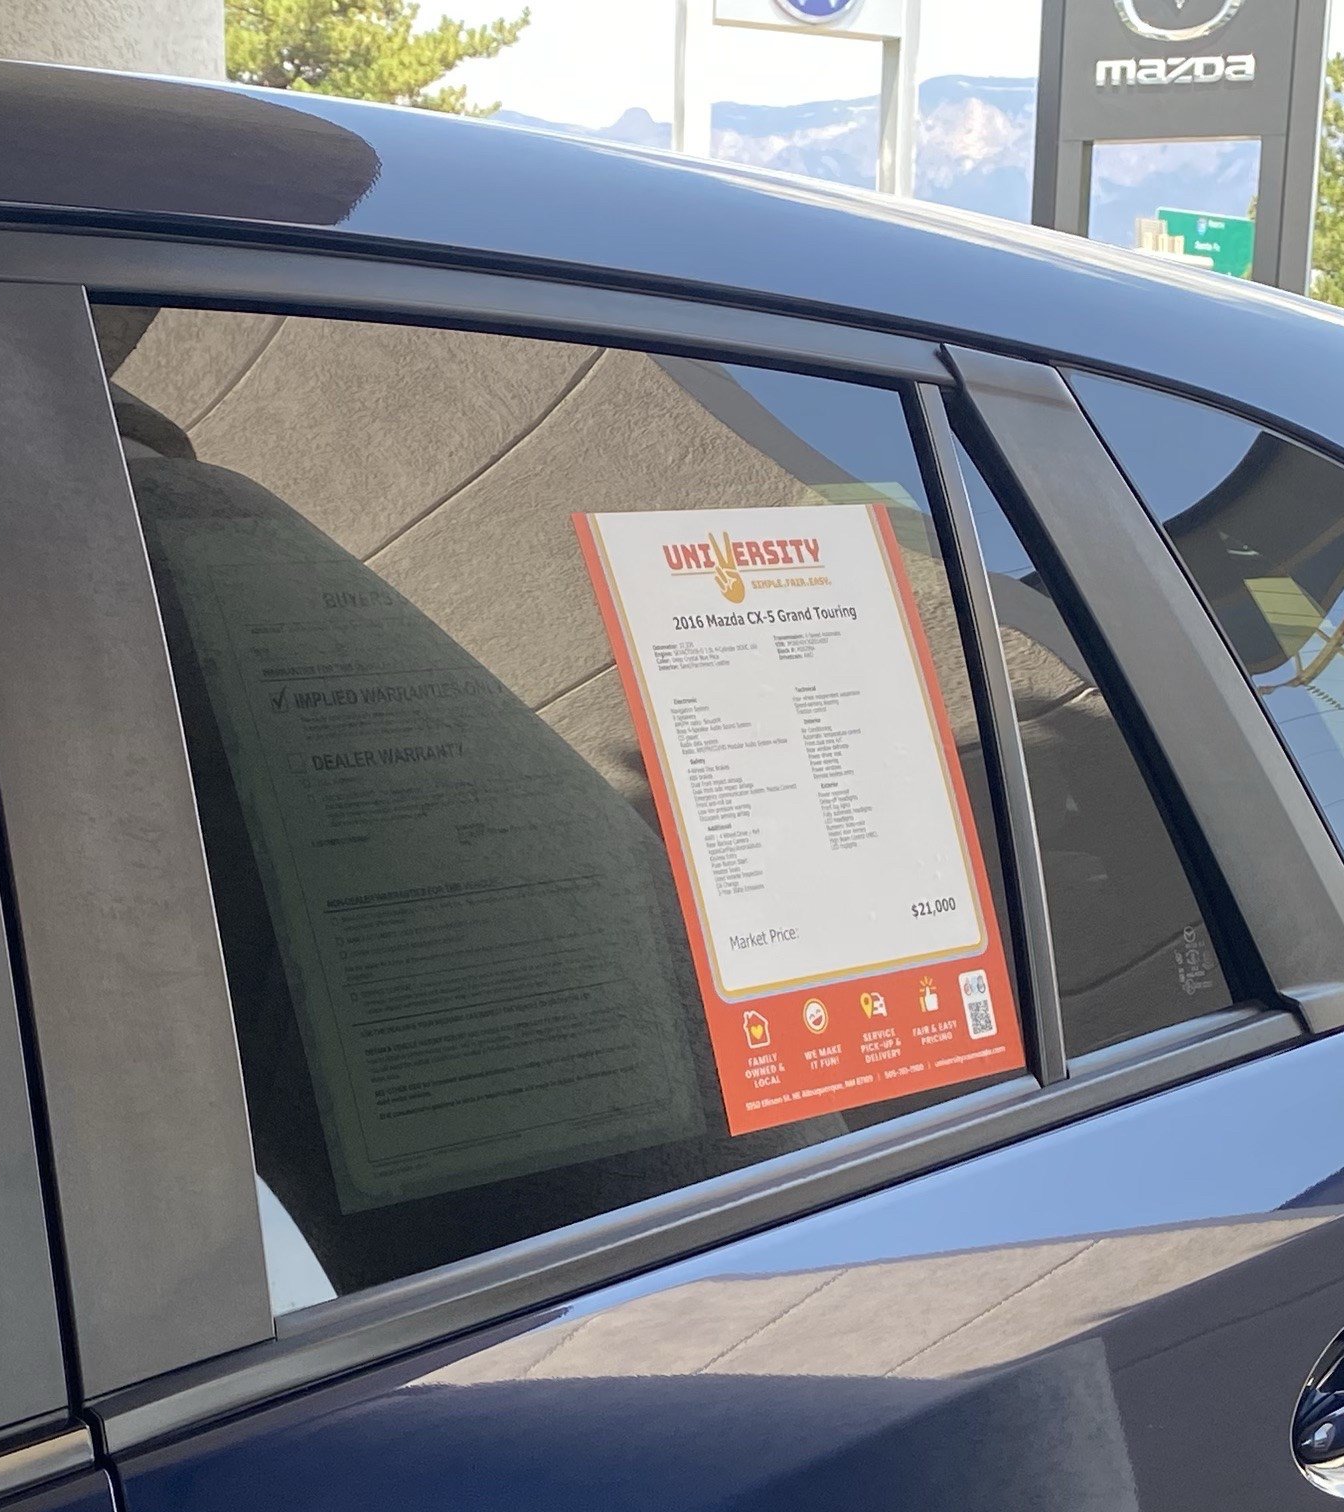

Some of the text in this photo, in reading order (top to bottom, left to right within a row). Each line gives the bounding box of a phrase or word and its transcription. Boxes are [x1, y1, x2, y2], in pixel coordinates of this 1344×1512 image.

[673, 604, 857, 630] 2016 Mazda CX-5 Grand Touring
[293, 688, 358, 710] IMPLIED
[361, 682, 460, 704] WARRANTIES
[312, 742, 463, 771] DEALER WARRANTY
[911, 896, 956, 919] $21,000
[729, 925, 800, 952] Market Price:
[862, 1028, 896, 1042] SERVICE
[912, 1025, 929, 1037] FAIR
[938, 1020, 957, 1032] EASY
[860, 1039, 894, 1053] PICK-UP
[921, 1032, 953, 1046] PRICING
[748, 1053, 778, 1067] FAMILY
[804, 1044, 842, 1060] WE MAKE
[865, 1048, 901, 1064] DELIVERY
[745, 1064, 776, 1079] OWNED
[810, 1060, 818, 1070] IT
[754, 1075, 781, 1088] LOCAL
